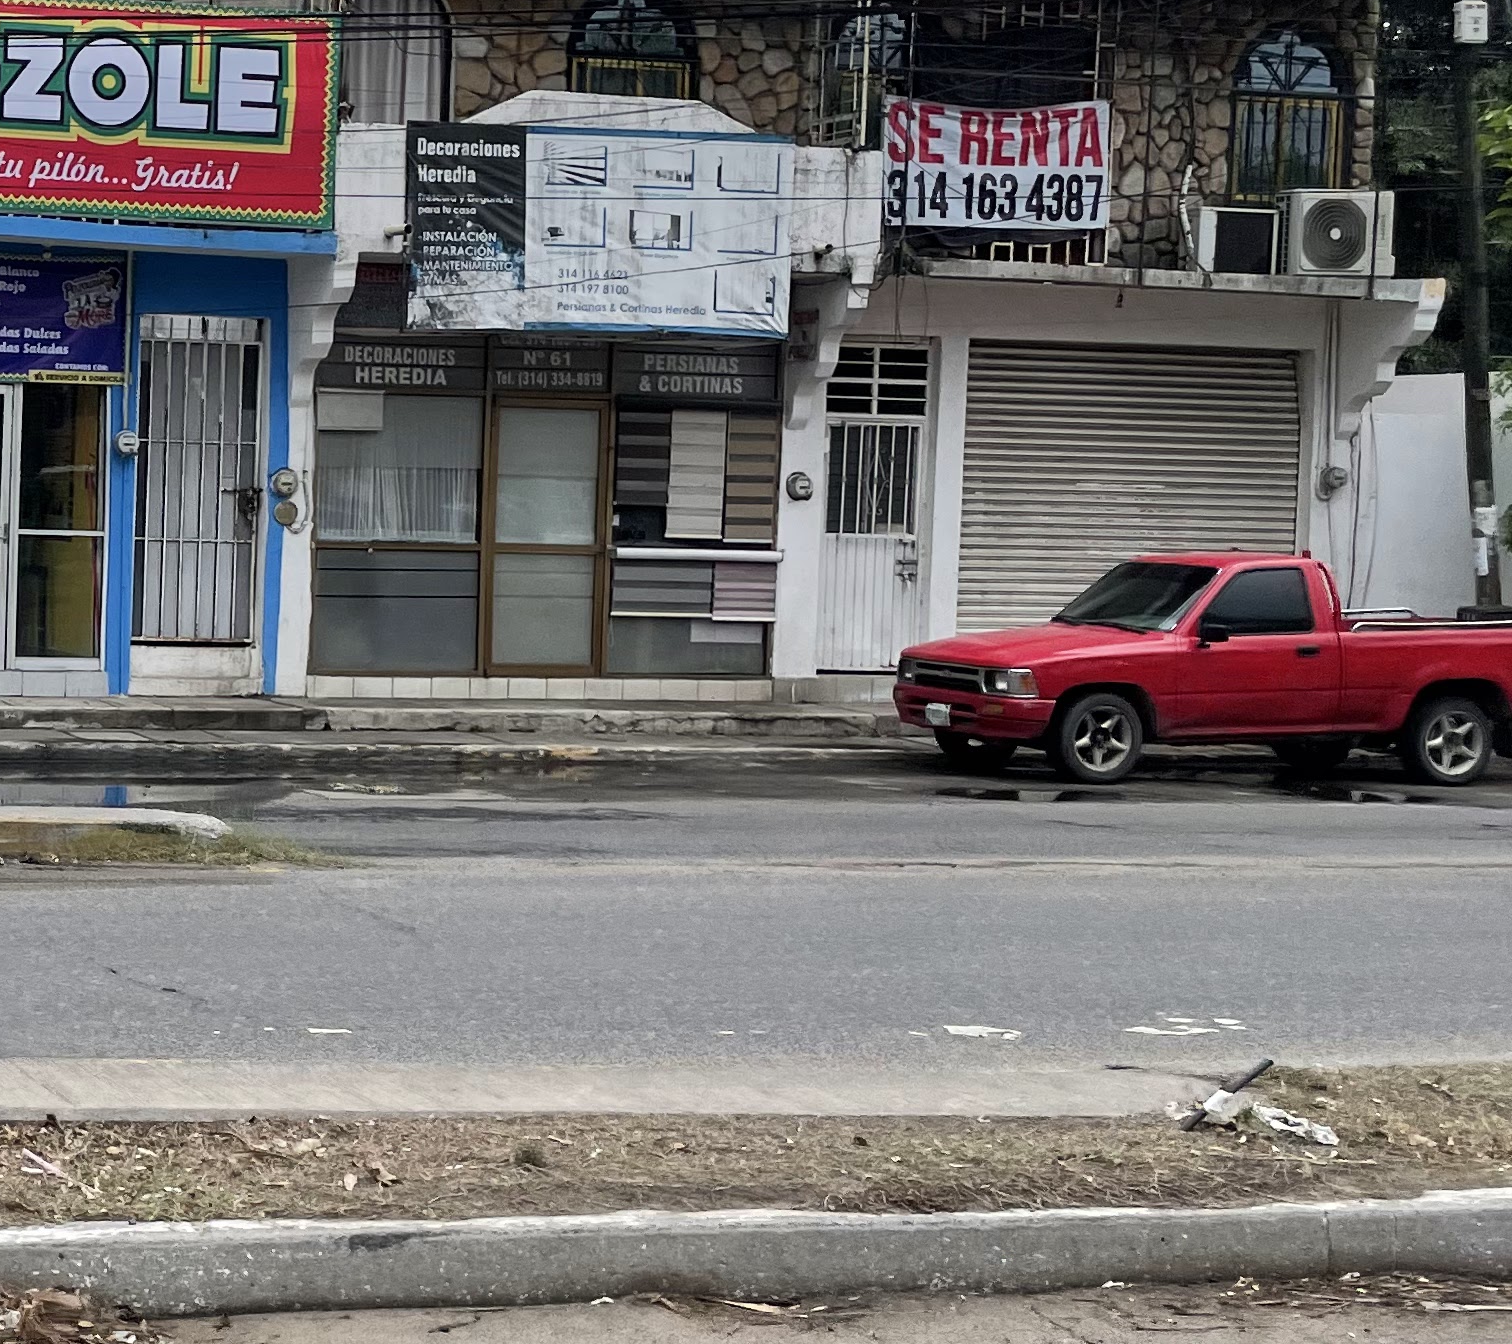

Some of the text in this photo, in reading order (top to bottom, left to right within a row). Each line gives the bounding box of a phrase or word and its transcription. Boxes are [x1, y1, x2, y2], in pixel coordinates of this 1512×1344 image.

[888, 102, 1104, 167] SE RENTA
[417, 137, 521, 158] Decoraciones
[417, 164, 476, 183] Heredia
[887, 169, 1104, 222] 314 163 4387
[417, 206, 441, 216] para
[453, 207, 477, 215] casa
[422, 229, 498, 243] INSTALACIÓN
[0, 266, 40, 277] Blanco
[422, 260, 514, 271] MANTENIMIENTO
[557, 268, 577, 278] 314
[581, 284, 599, 294] 197
[603, 284, 629, 295] 8100
[556, 302, 707, 316] Persianas & Cortinas Heredia
[23, 327, 61, 339] Dulces
[23, 342, 69, 355] Saladas
[344, 346, 456, 366] DECORACIONES
[550, 351, 572, 366] 61
[644, 355, 739, 374] PERSIANAS
[355, 366, 447, 386] HEREDIA
[496, 371, 515, 386] Tel.
[518, 370, 547, 388] (314)
[639, 375, 744, 394] & CORTINAS
